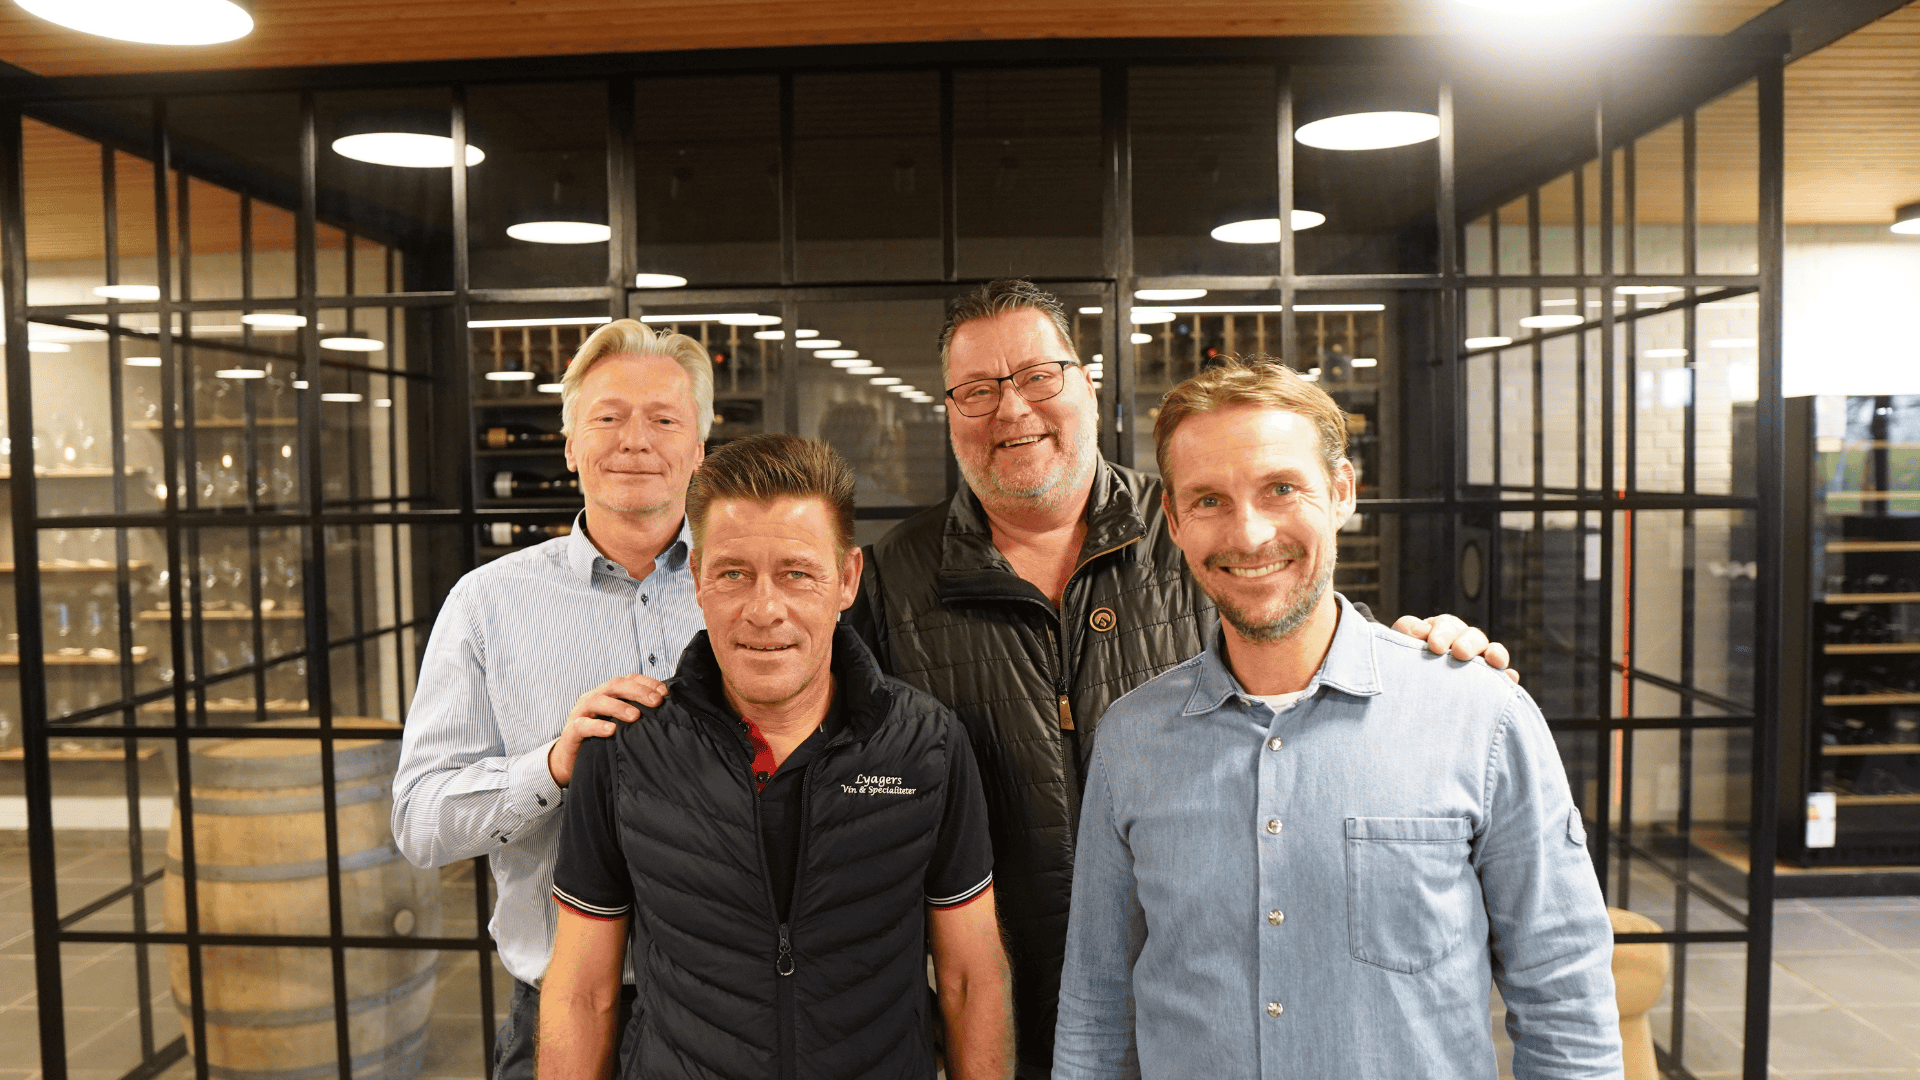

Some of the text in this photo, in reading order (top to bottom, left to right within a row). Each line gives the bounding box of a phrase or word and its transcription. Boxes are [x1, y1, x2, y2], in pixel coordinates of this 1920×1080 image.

[855, 773, 902, 787] Lyagers
[840, 784, 916, 796] Vin & Specialiteter
